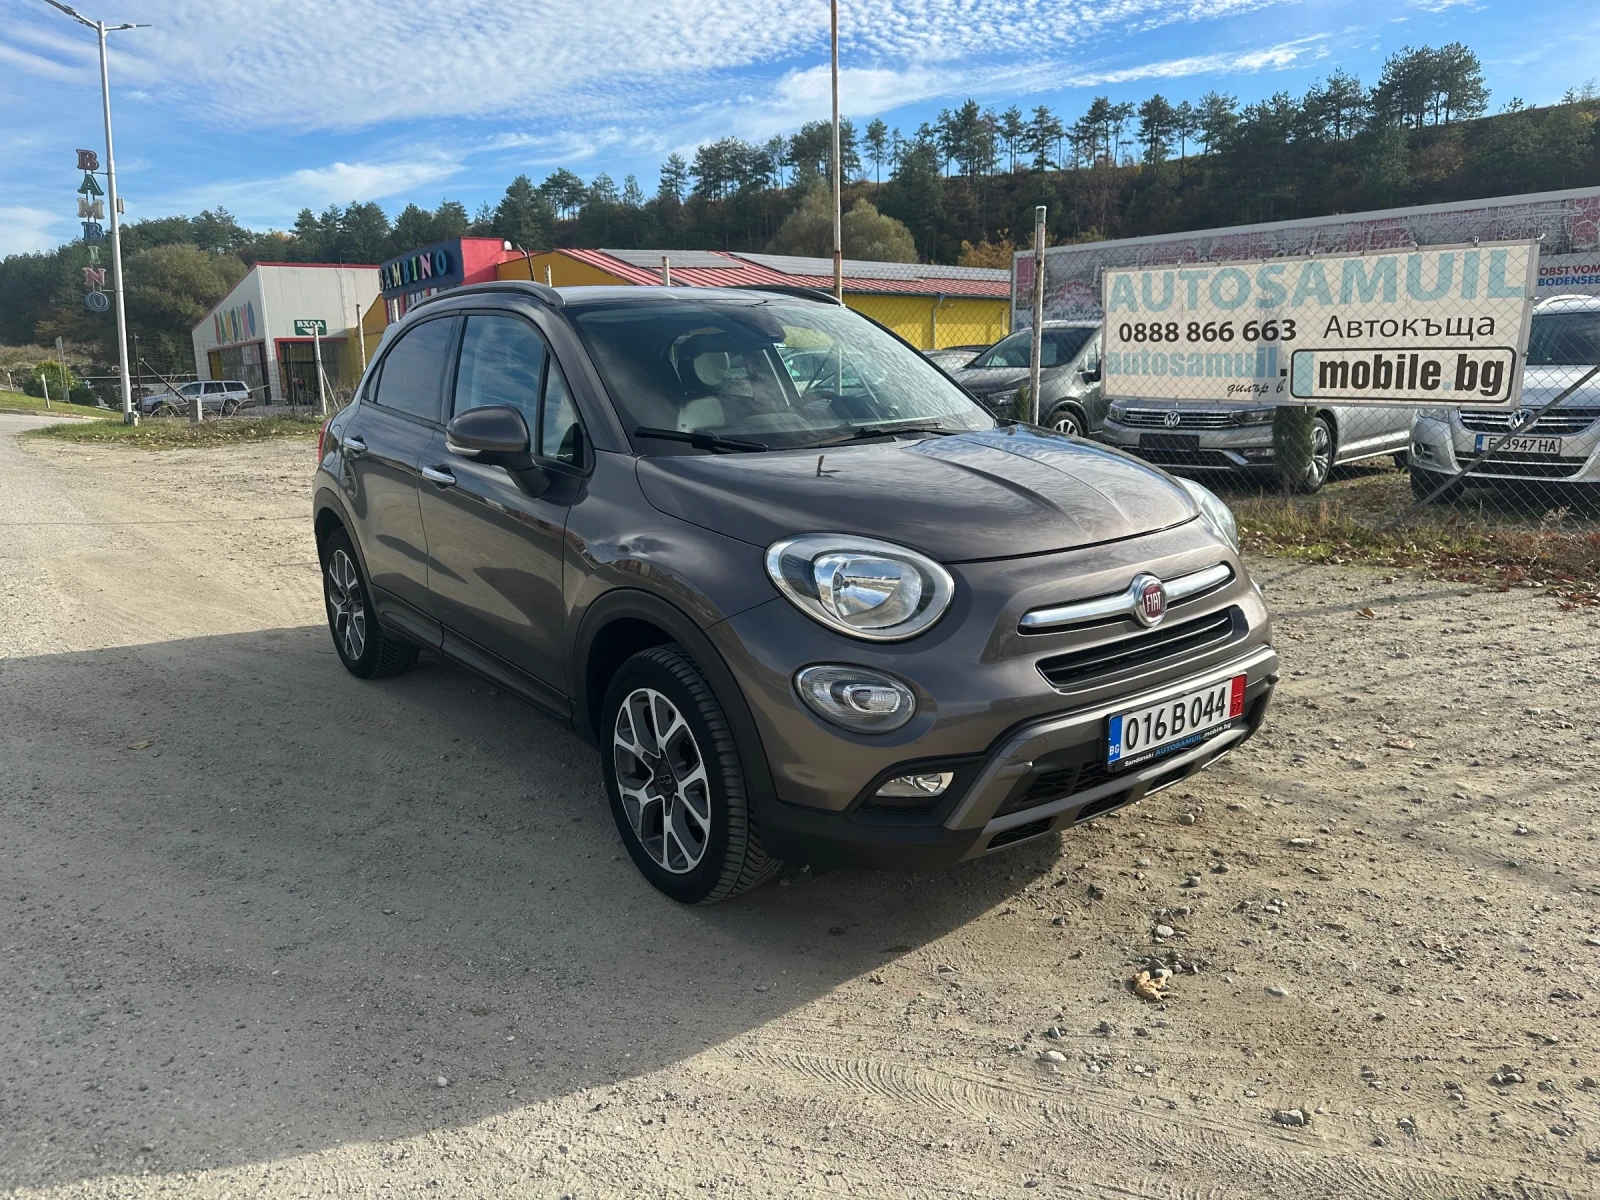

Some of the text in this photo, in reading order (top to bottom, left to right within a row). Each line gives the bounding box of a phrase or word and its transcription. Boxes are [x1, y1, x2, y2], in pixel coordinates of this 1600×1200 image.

[76, 149, 110, 312] BAMBINO
[378, 249, 447, 292] BAMBINO
[1107, 250, 1527, 313] AUTOSAMUIL
[1538, 275, 1600, 287] BODENSEE
[1539, 266, 1571, 276] OBST
[214, 300, 256, 345] BAMBINO
[1119, 319, 1297, 343] 0888 866 663
[1323, 315, 1496, 342] Автокъща
[1318, 353, 1505, 397] mobile.bg
[1145, 591, 1161, 613] FIAT
[1125, 686, 1227, 750] 016B044
[1109, 744, 1120, 756] BG
